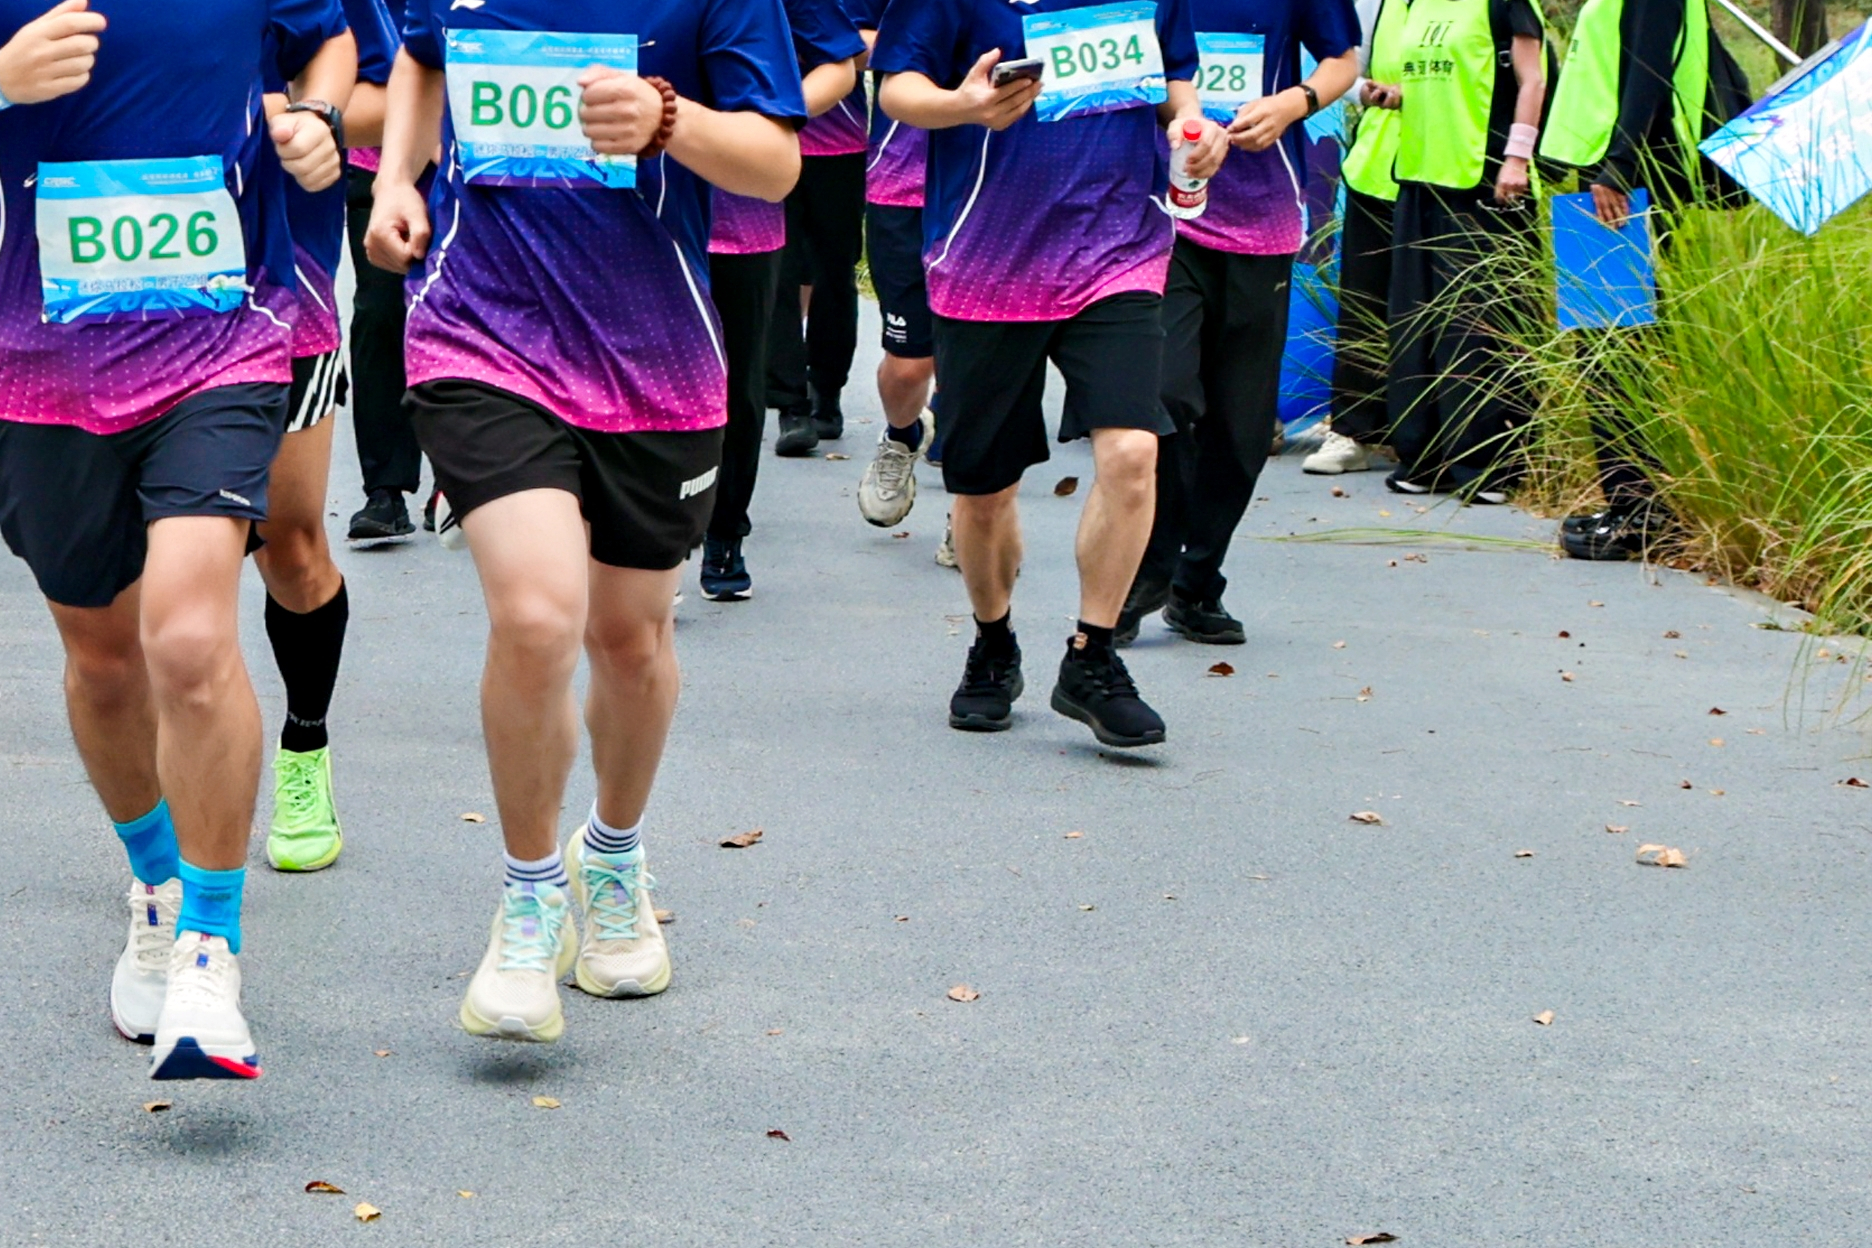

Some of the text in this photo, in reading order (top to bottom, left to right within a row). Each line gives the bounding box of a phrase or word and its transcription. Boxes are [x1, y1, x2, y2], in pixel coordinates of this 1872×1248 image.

[1050, 34, 1144, 79] B034
[1195, 64, 1246, 91] 28
[470, 81, 584, 129] B06
[68, 210, 219, 264] B026
